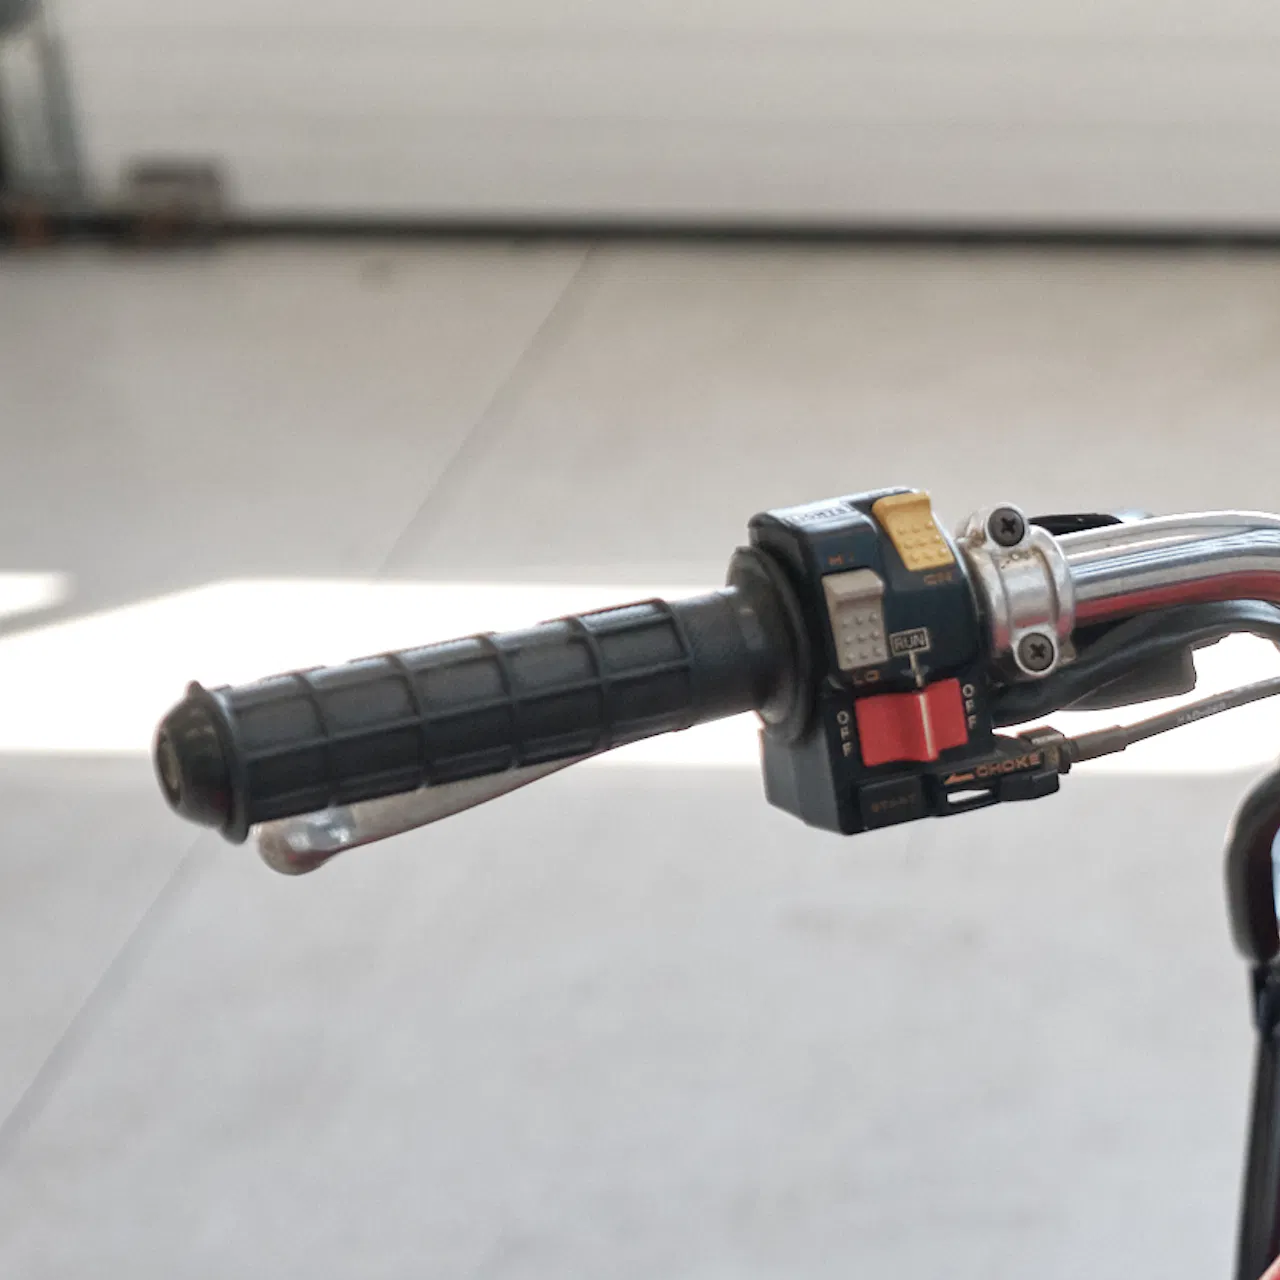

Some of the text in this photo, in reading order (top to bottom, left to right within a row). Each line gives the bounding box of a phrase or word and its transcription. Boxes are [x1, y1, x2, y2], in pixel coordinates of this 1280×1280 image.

[962, 684, 977, 730] OFF
[837, 710, 852, 758] OFF
[976, 751, 1041, 778] CHOKE
